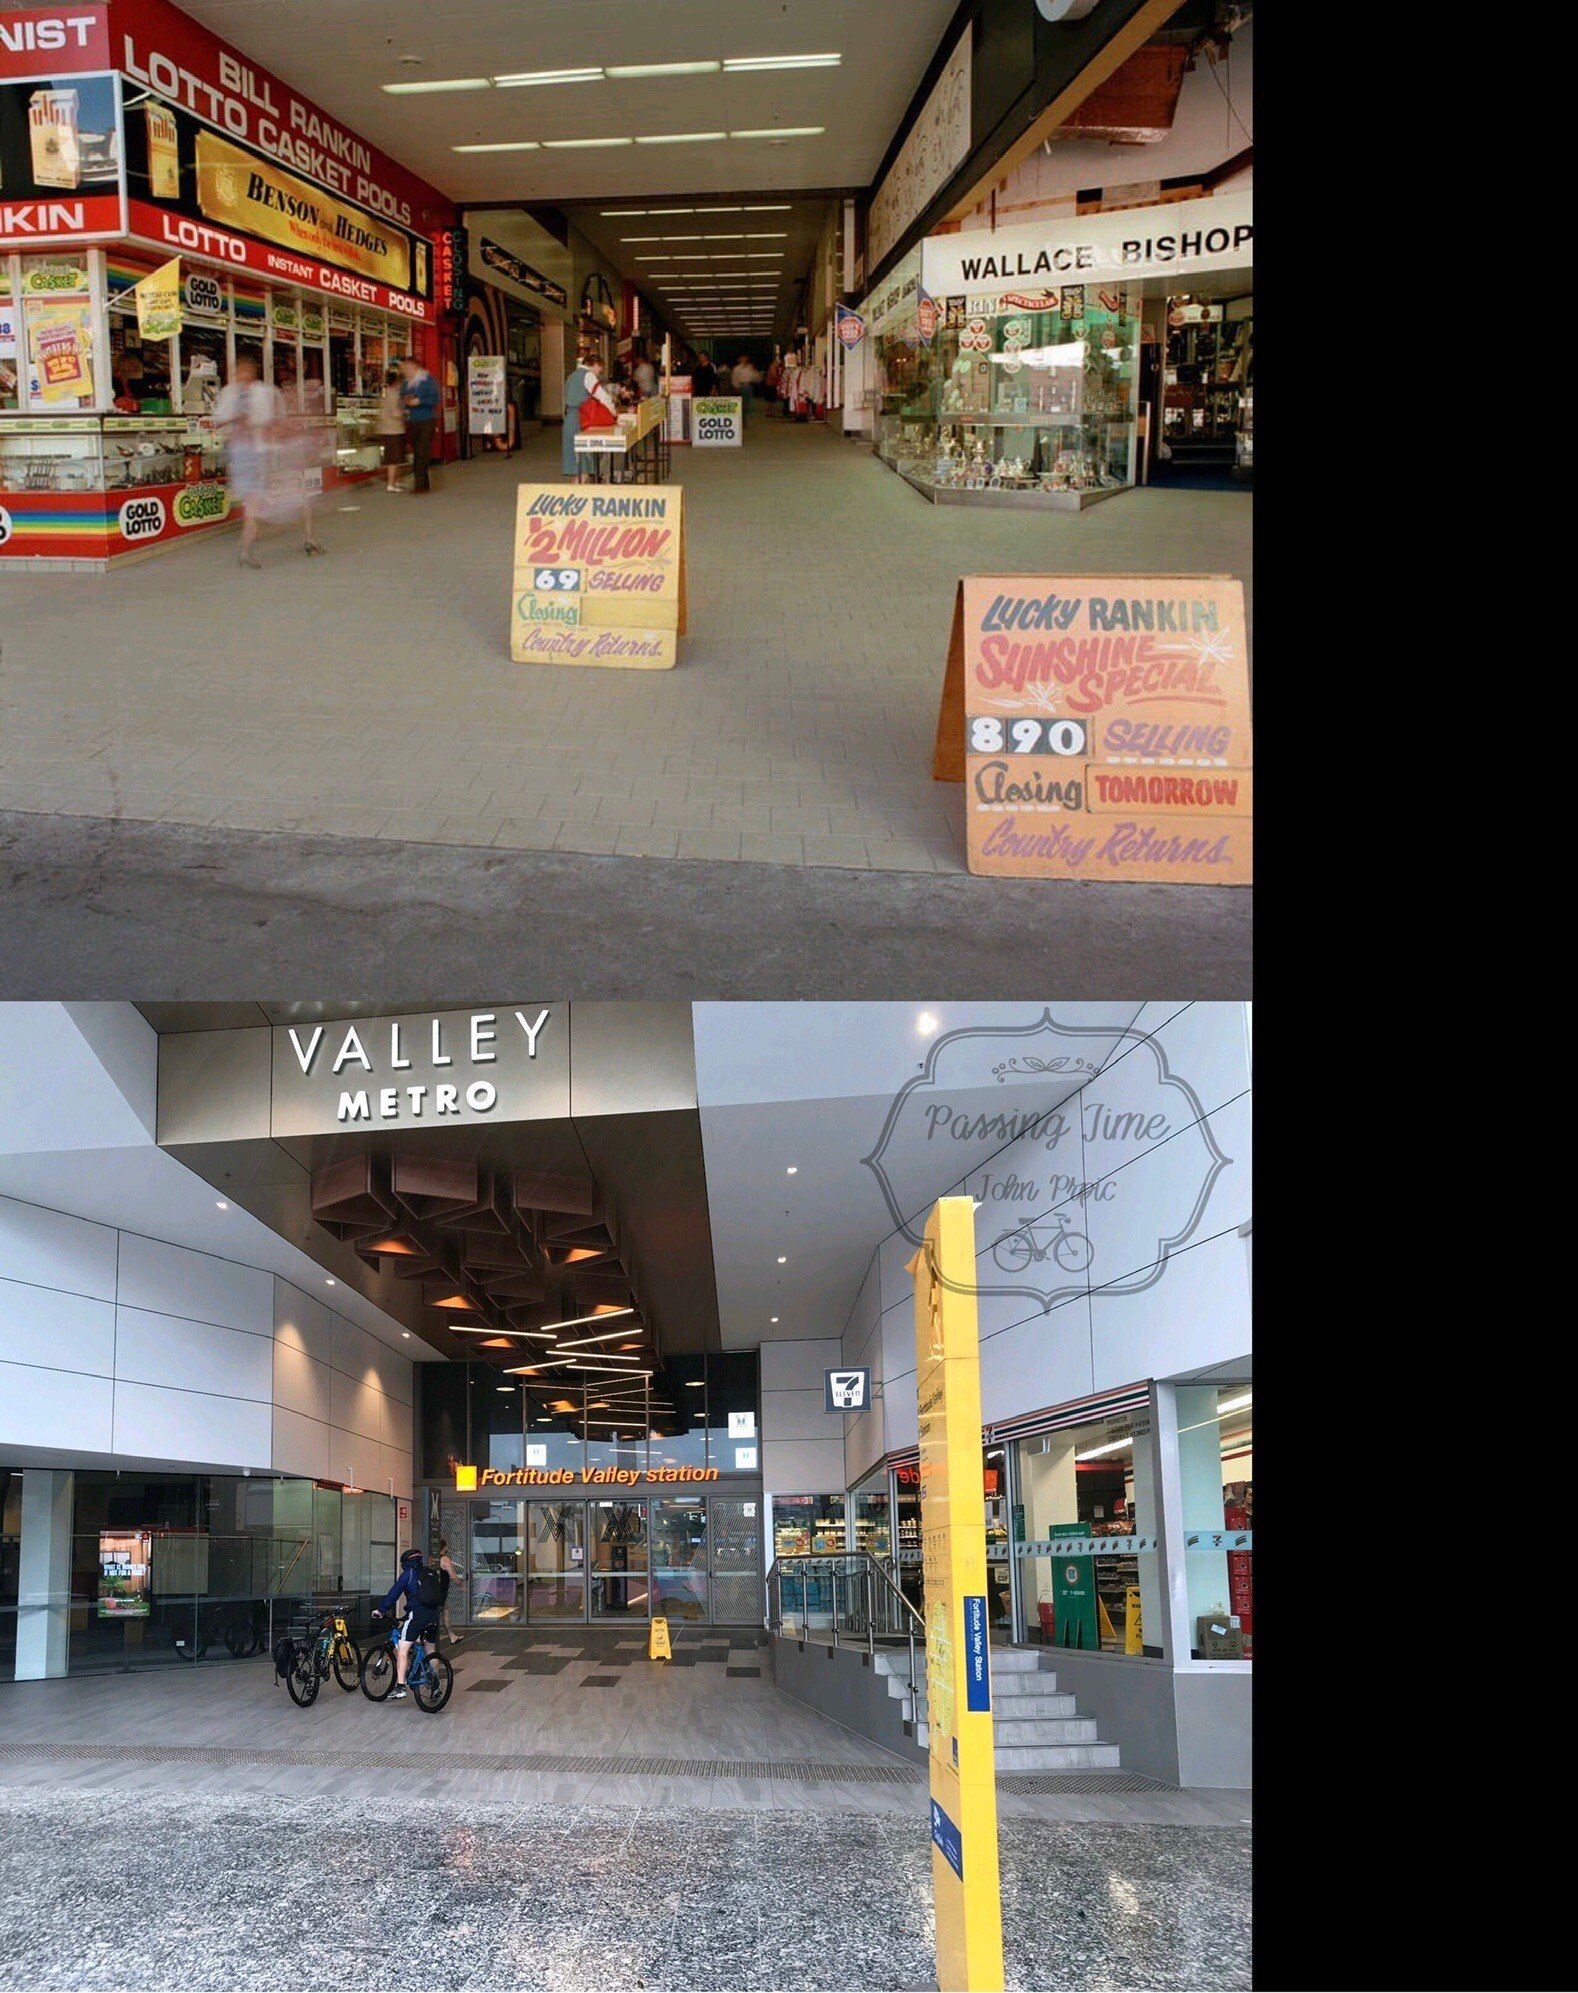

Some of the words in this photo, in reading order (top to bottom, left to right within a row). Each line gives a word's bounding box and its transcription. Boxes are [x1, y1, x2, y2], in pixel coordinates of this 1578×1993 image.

[124, 34, 248, 138] LOTTO
[258, 118, 352, 194] CASKET
[357, 177, 411, 226] POOLS
[218, 51, 280, 117] BILL
[290, 99, 371, 175] RANKIN
[0, 203, 84, 233] KIN
[247, 172, 320, 226] BENSON
[335, 214, 388, 257] HEDGES
[163, 216, 247, 263] LOTTO
[267, 254, 314, 280] INSTANT
[320, 268, 377, 302] CASKET
[388, 291, 425, 317] POOLS
[442, 231, 453, 309] CASKET
[962, 245, 1094, 281] WALLACE
[1122, 224, 1253, 264] BISHOP
[190, 277, 217, 295] GOLD
[190, 292, 220, 309] LOTTO
[699, 417, 732, 428] GOLD
[699, 429, 735, 440] LOTTO
[126, 501, 159, 518] GOLD
[526, 493, 588, 516] LUCKY
[591, 497, 666, 518] RANKIN
[126, 516, 161, 535] LOTTO
[557, 518, 672, 566] MILLION
[535, 570, 579, 590] 69
[588, 570, 665, 592] SELLING
[517, 591, 578, 625] Closing
[981, 593, 1082, 632] LUCKY
[1088, 597, 1218, 633] RANKIN
[522, 626, 589, 657] Country
[975, 634, 1156, 693] SUNSHINE
[1066, 661, 1223, 713] SPECIAL
[970, 716, 1085, 756] 890
[1103, 718, 1231, 757] SELLING
[975, 761, 1083, 811] Closing
[1094, 775, 1238, 806] TOMORROW
[981, 815, 1095, 866] Country
[288, 1009, 550, 1077] VALLEY
[337, 1080, 498, 1122] METRO
[481, 1467, 574, 1486] Fortitude
[581, 1466, 641, 1487] Valley
[646, 1464, 719, 1483] station
[973, 1598, 981, 1631] Fortitude
[973, 1632, 982, 1655] Valley
[974, 1655, 983, 1681] Station
